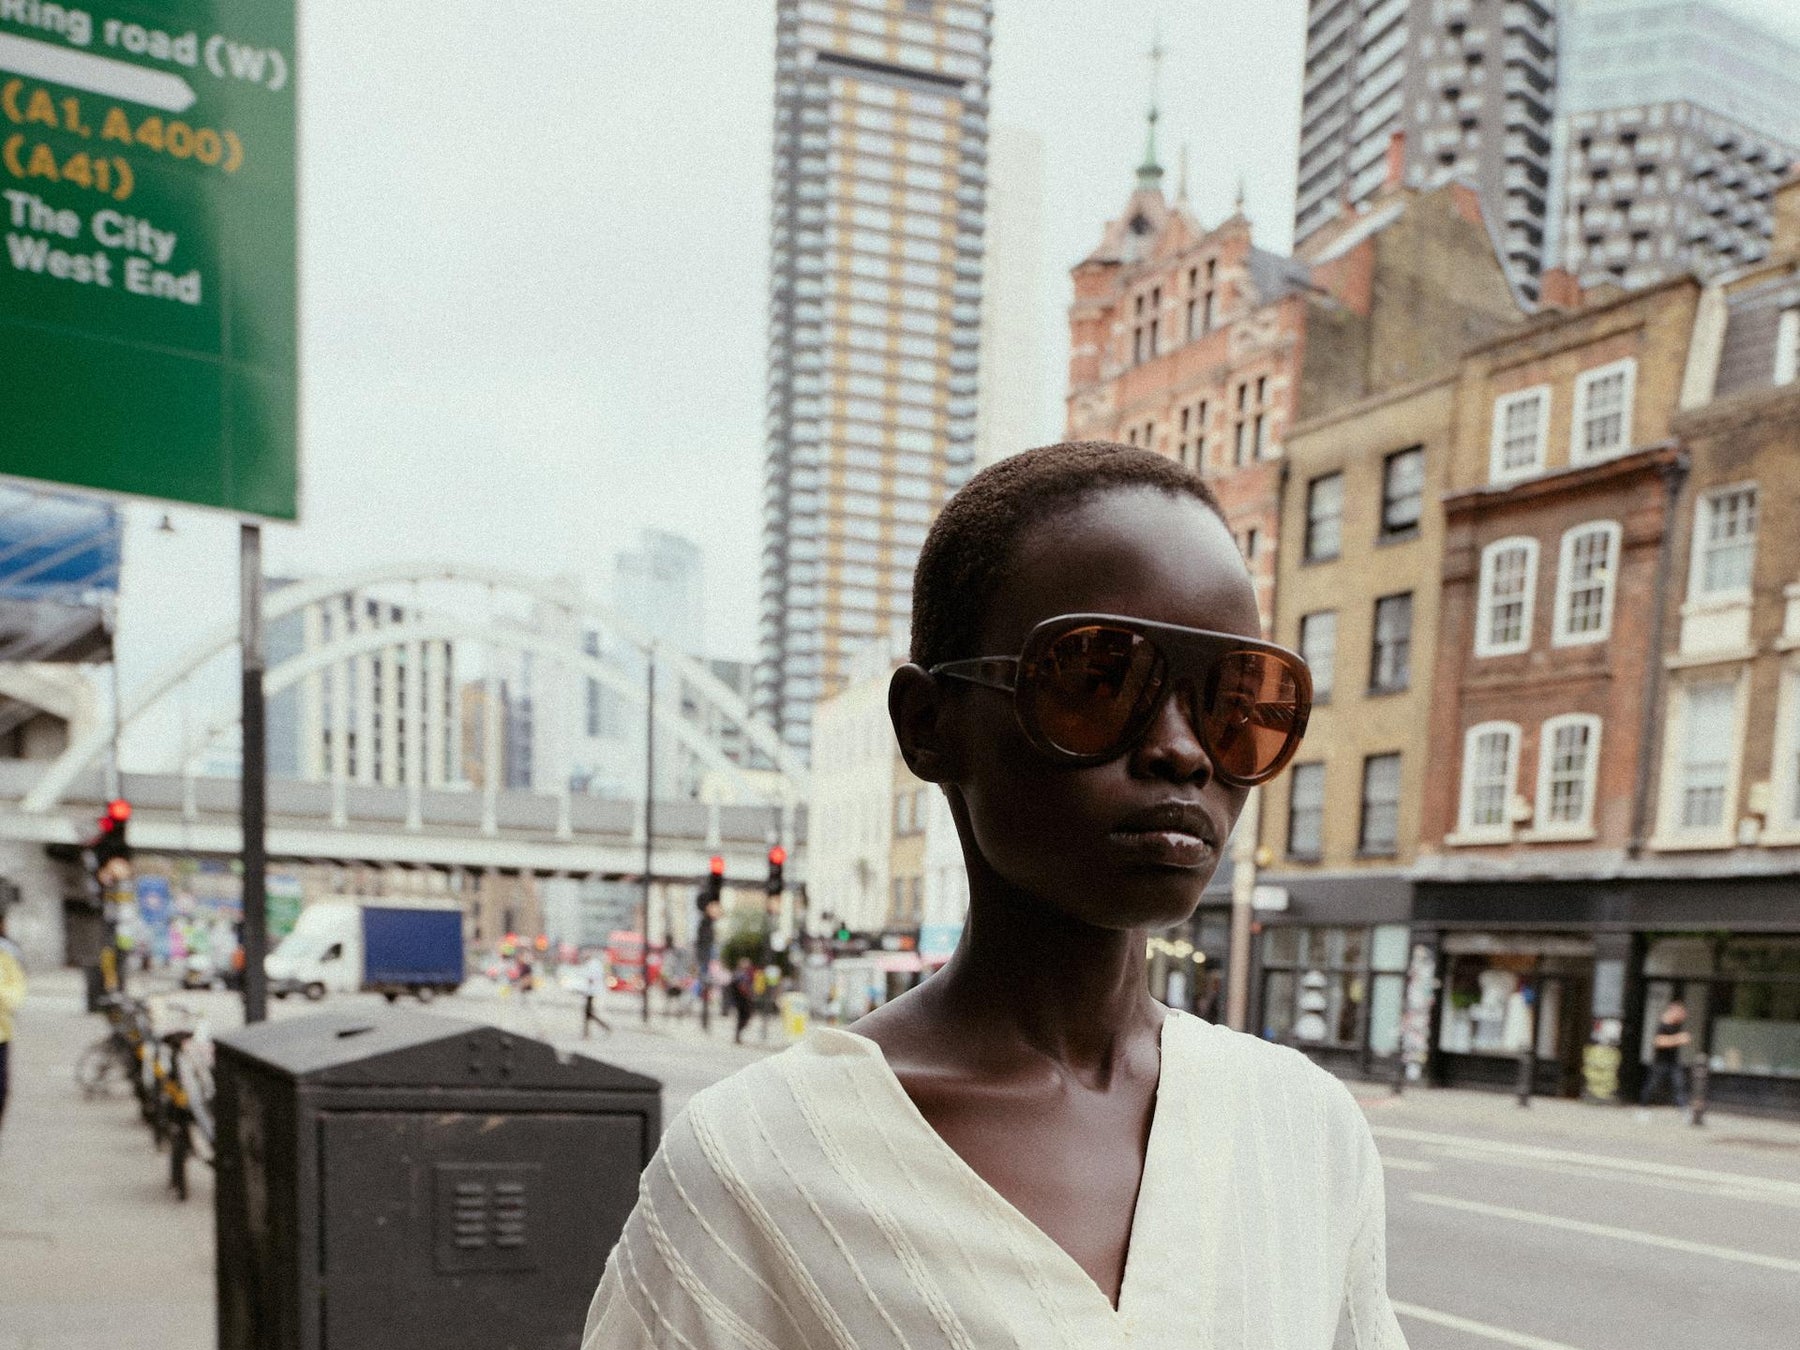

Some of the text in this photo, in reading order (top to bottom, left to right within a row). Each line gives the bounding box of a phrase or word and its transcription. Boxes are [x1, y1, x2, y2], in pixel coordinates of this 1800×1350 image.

[103, 18, 197, 67] road
[204, 35, 288, 91] (W)
[3, 134, 135, 200] (A41)
[102, 106, 245, 173] A400)
[3, 188, 177, 265] The City
[5, 232, 202, 305] West End
